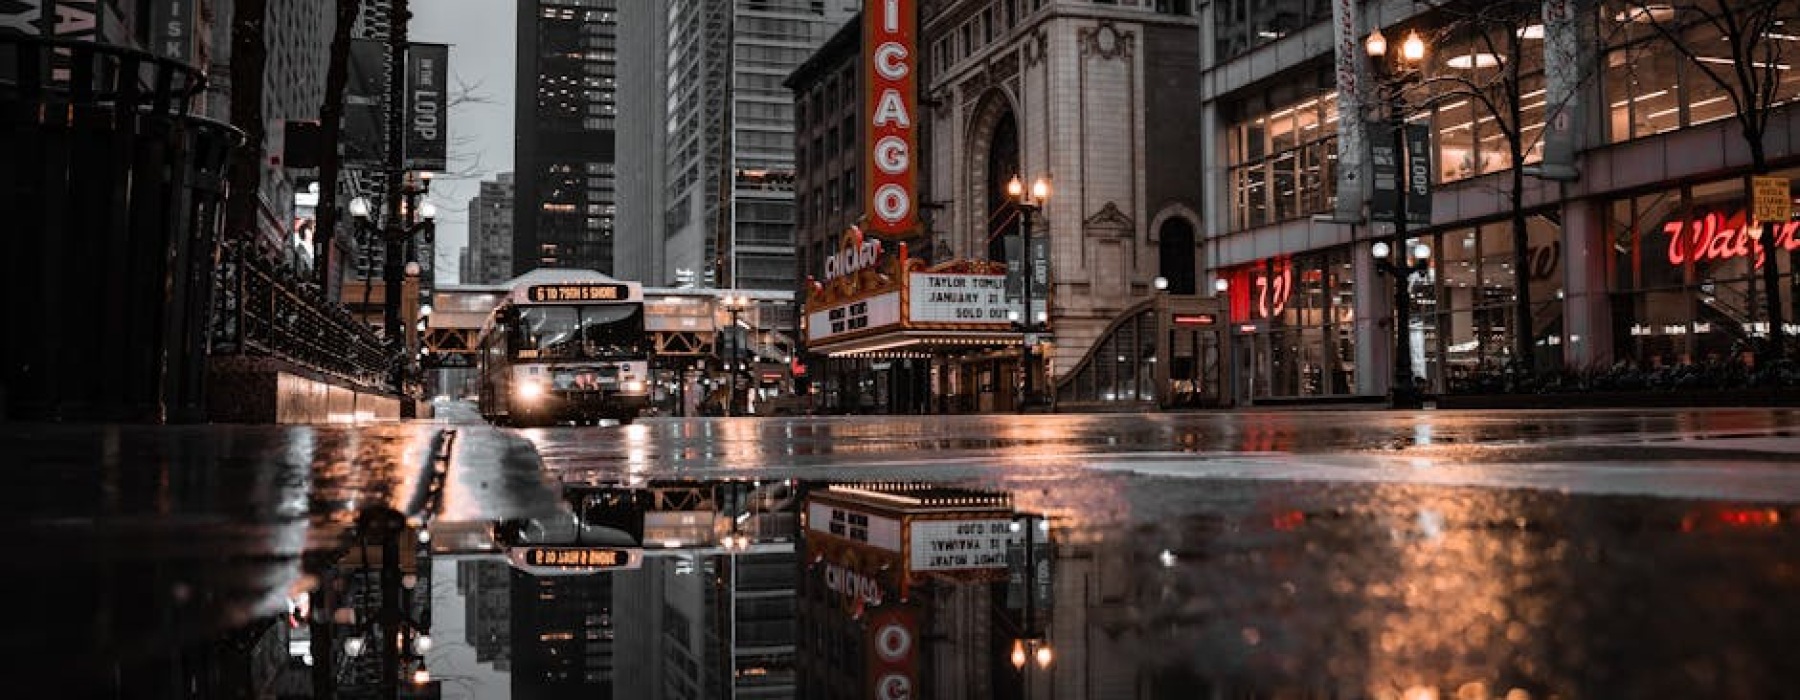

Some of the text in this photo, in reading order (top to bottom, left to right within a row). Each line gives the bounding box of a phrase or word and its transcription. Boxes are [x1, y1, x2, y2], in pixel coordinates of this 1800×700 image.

[413, 90, 438, 140] LOOP
[1412, 156, 1428, 196] LOOP
[824, 238, 882, 280] CHICAGO
[929, 277, 966, 288] TAYLOR
[929, 292, 979, 302] JANUARY
[957, 307, 1009, 318] SOLD OUT
